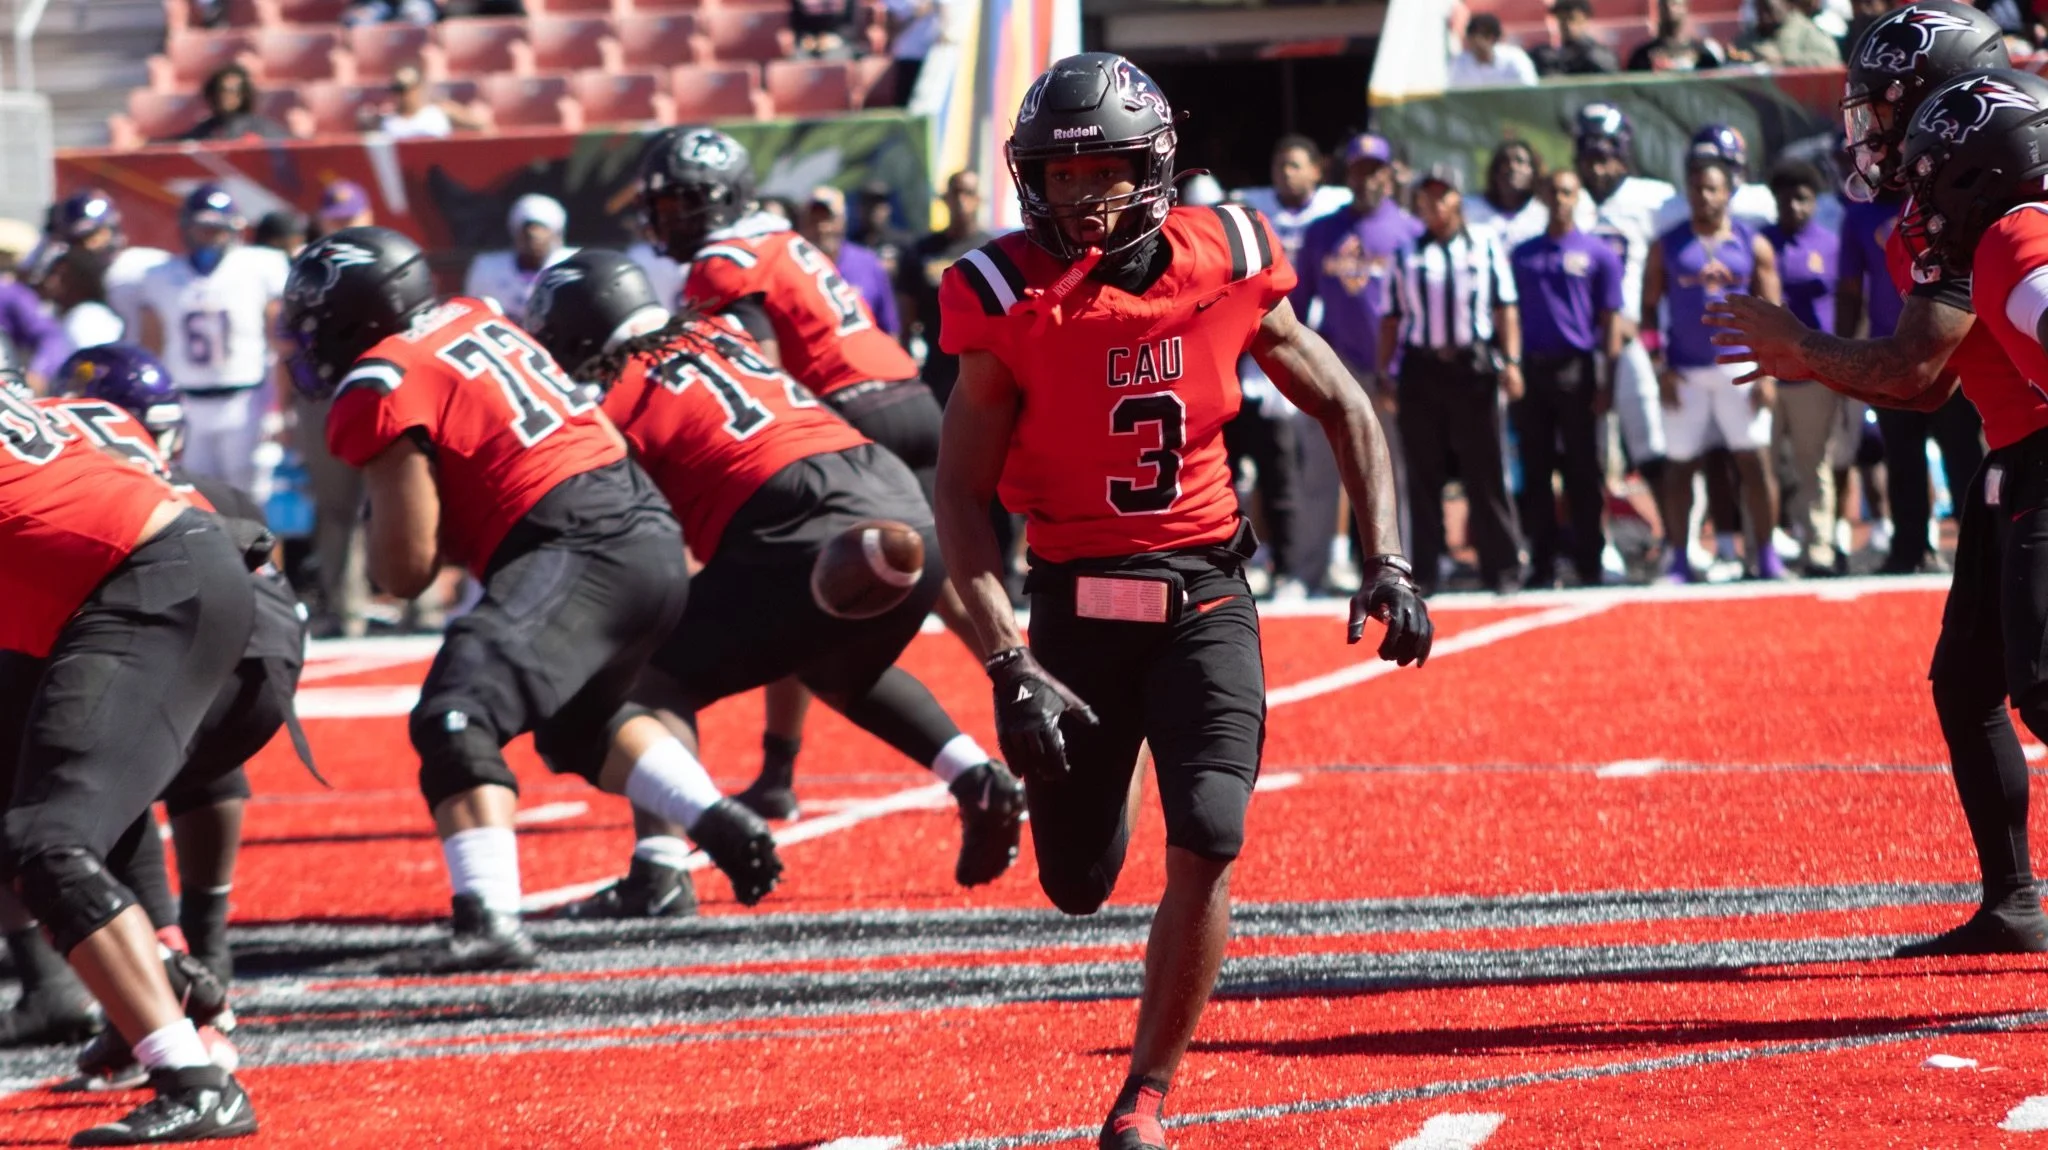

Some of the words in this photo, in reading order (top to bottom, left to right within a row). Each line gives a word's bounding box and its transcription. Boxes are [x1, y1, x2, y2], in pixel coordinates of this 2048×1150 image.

[1053, 125, 1098, 140] Riddell
[1052, 267, 1084, 298] NXTRND
[436, 319, 600, 448] 72
[1107, 336, 1183, 388] CAU
[1106, 390, 1186, 517] 3
